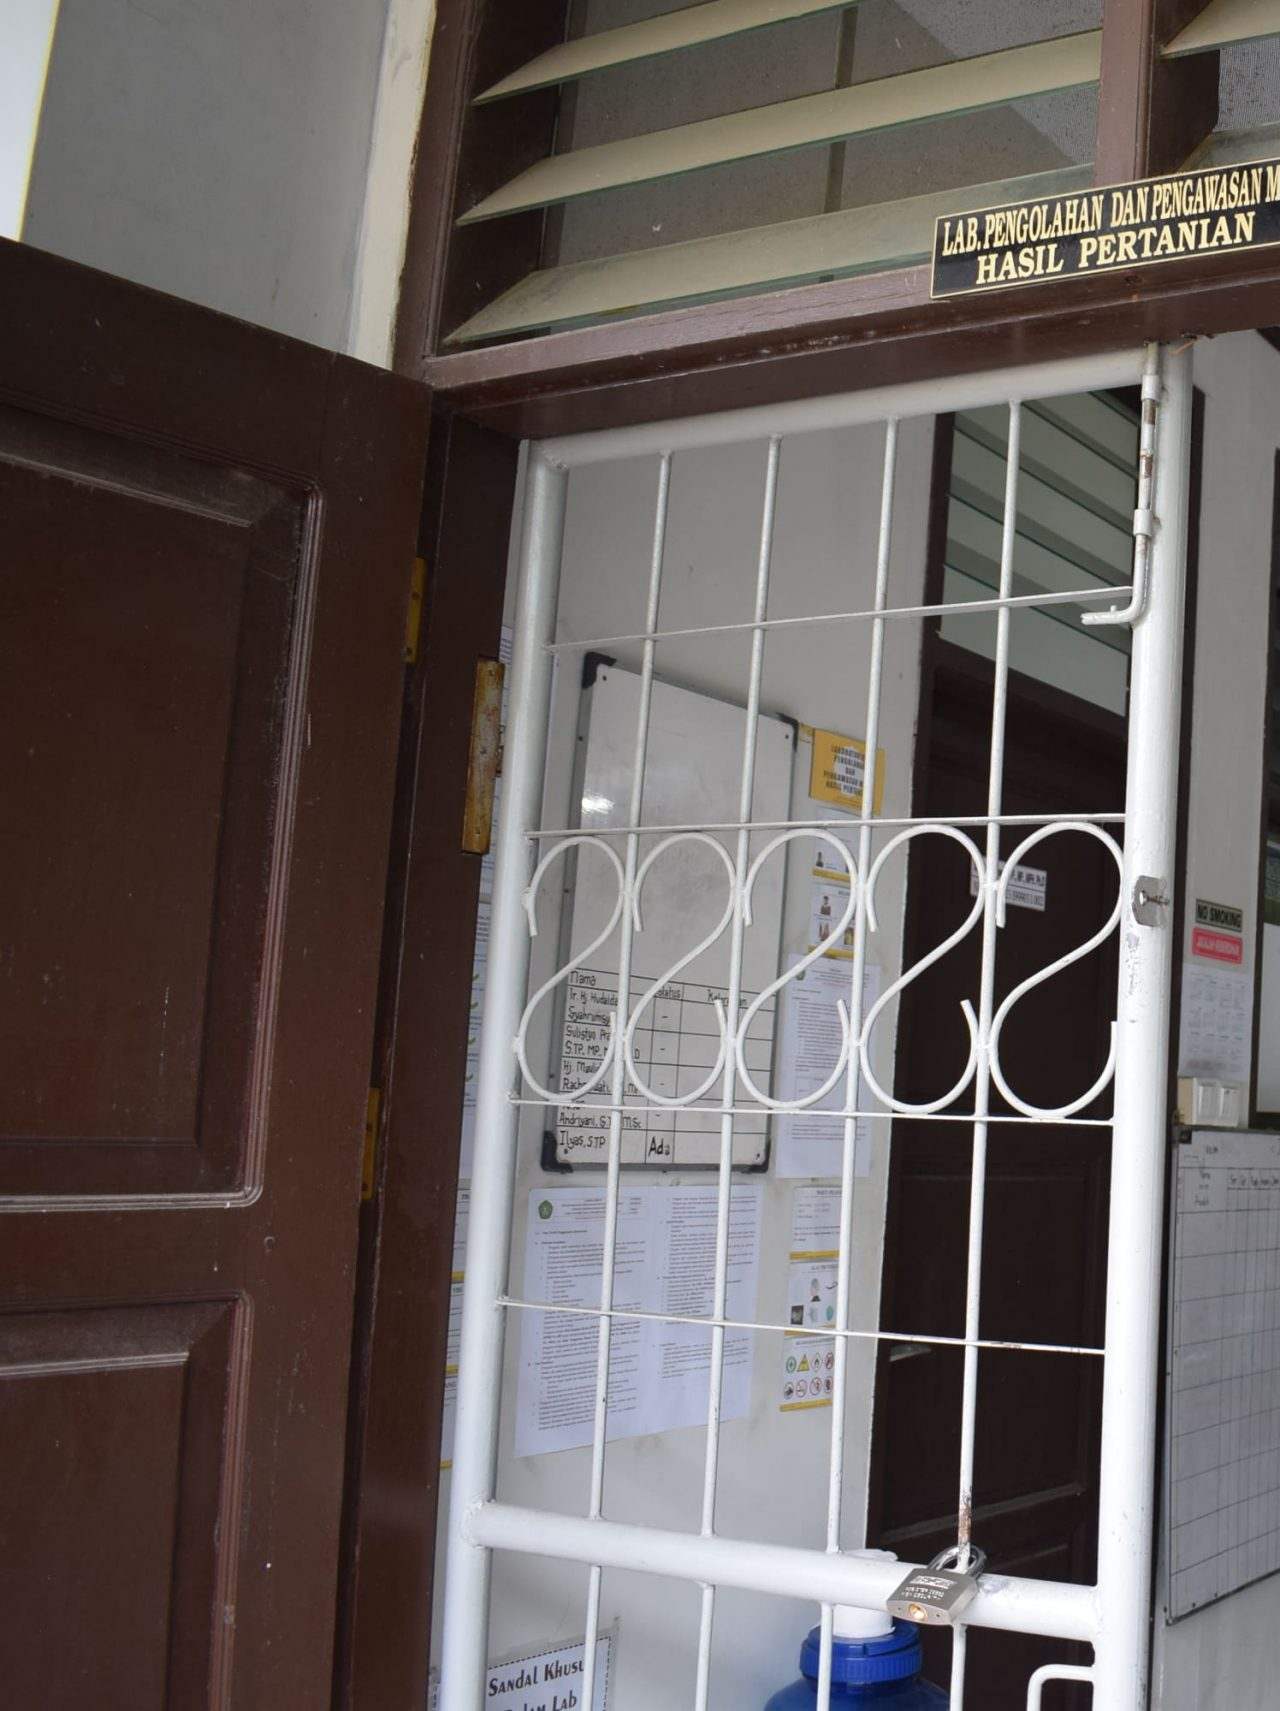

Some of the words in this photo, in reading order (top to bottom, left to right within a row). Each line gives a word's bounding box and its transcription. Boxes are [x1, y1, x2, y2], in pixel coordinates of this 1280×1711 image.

[942, 216, 981, 257] LAB.
[983, 194, 1103, 250] PENGOLAHAN
[1110, 186, 1150, 228] DAN
[1151, 167, 1263, 221] PENGAWASAN
[976, 243, 1064, 285] HASIL
[1078, 211, 1256, 269] PERTANIAN
[1197, 903, 1208, 920] NO
[1209, 906, 1242, 929] SMOKING
[648, 1136, 671, 1157] Ada
